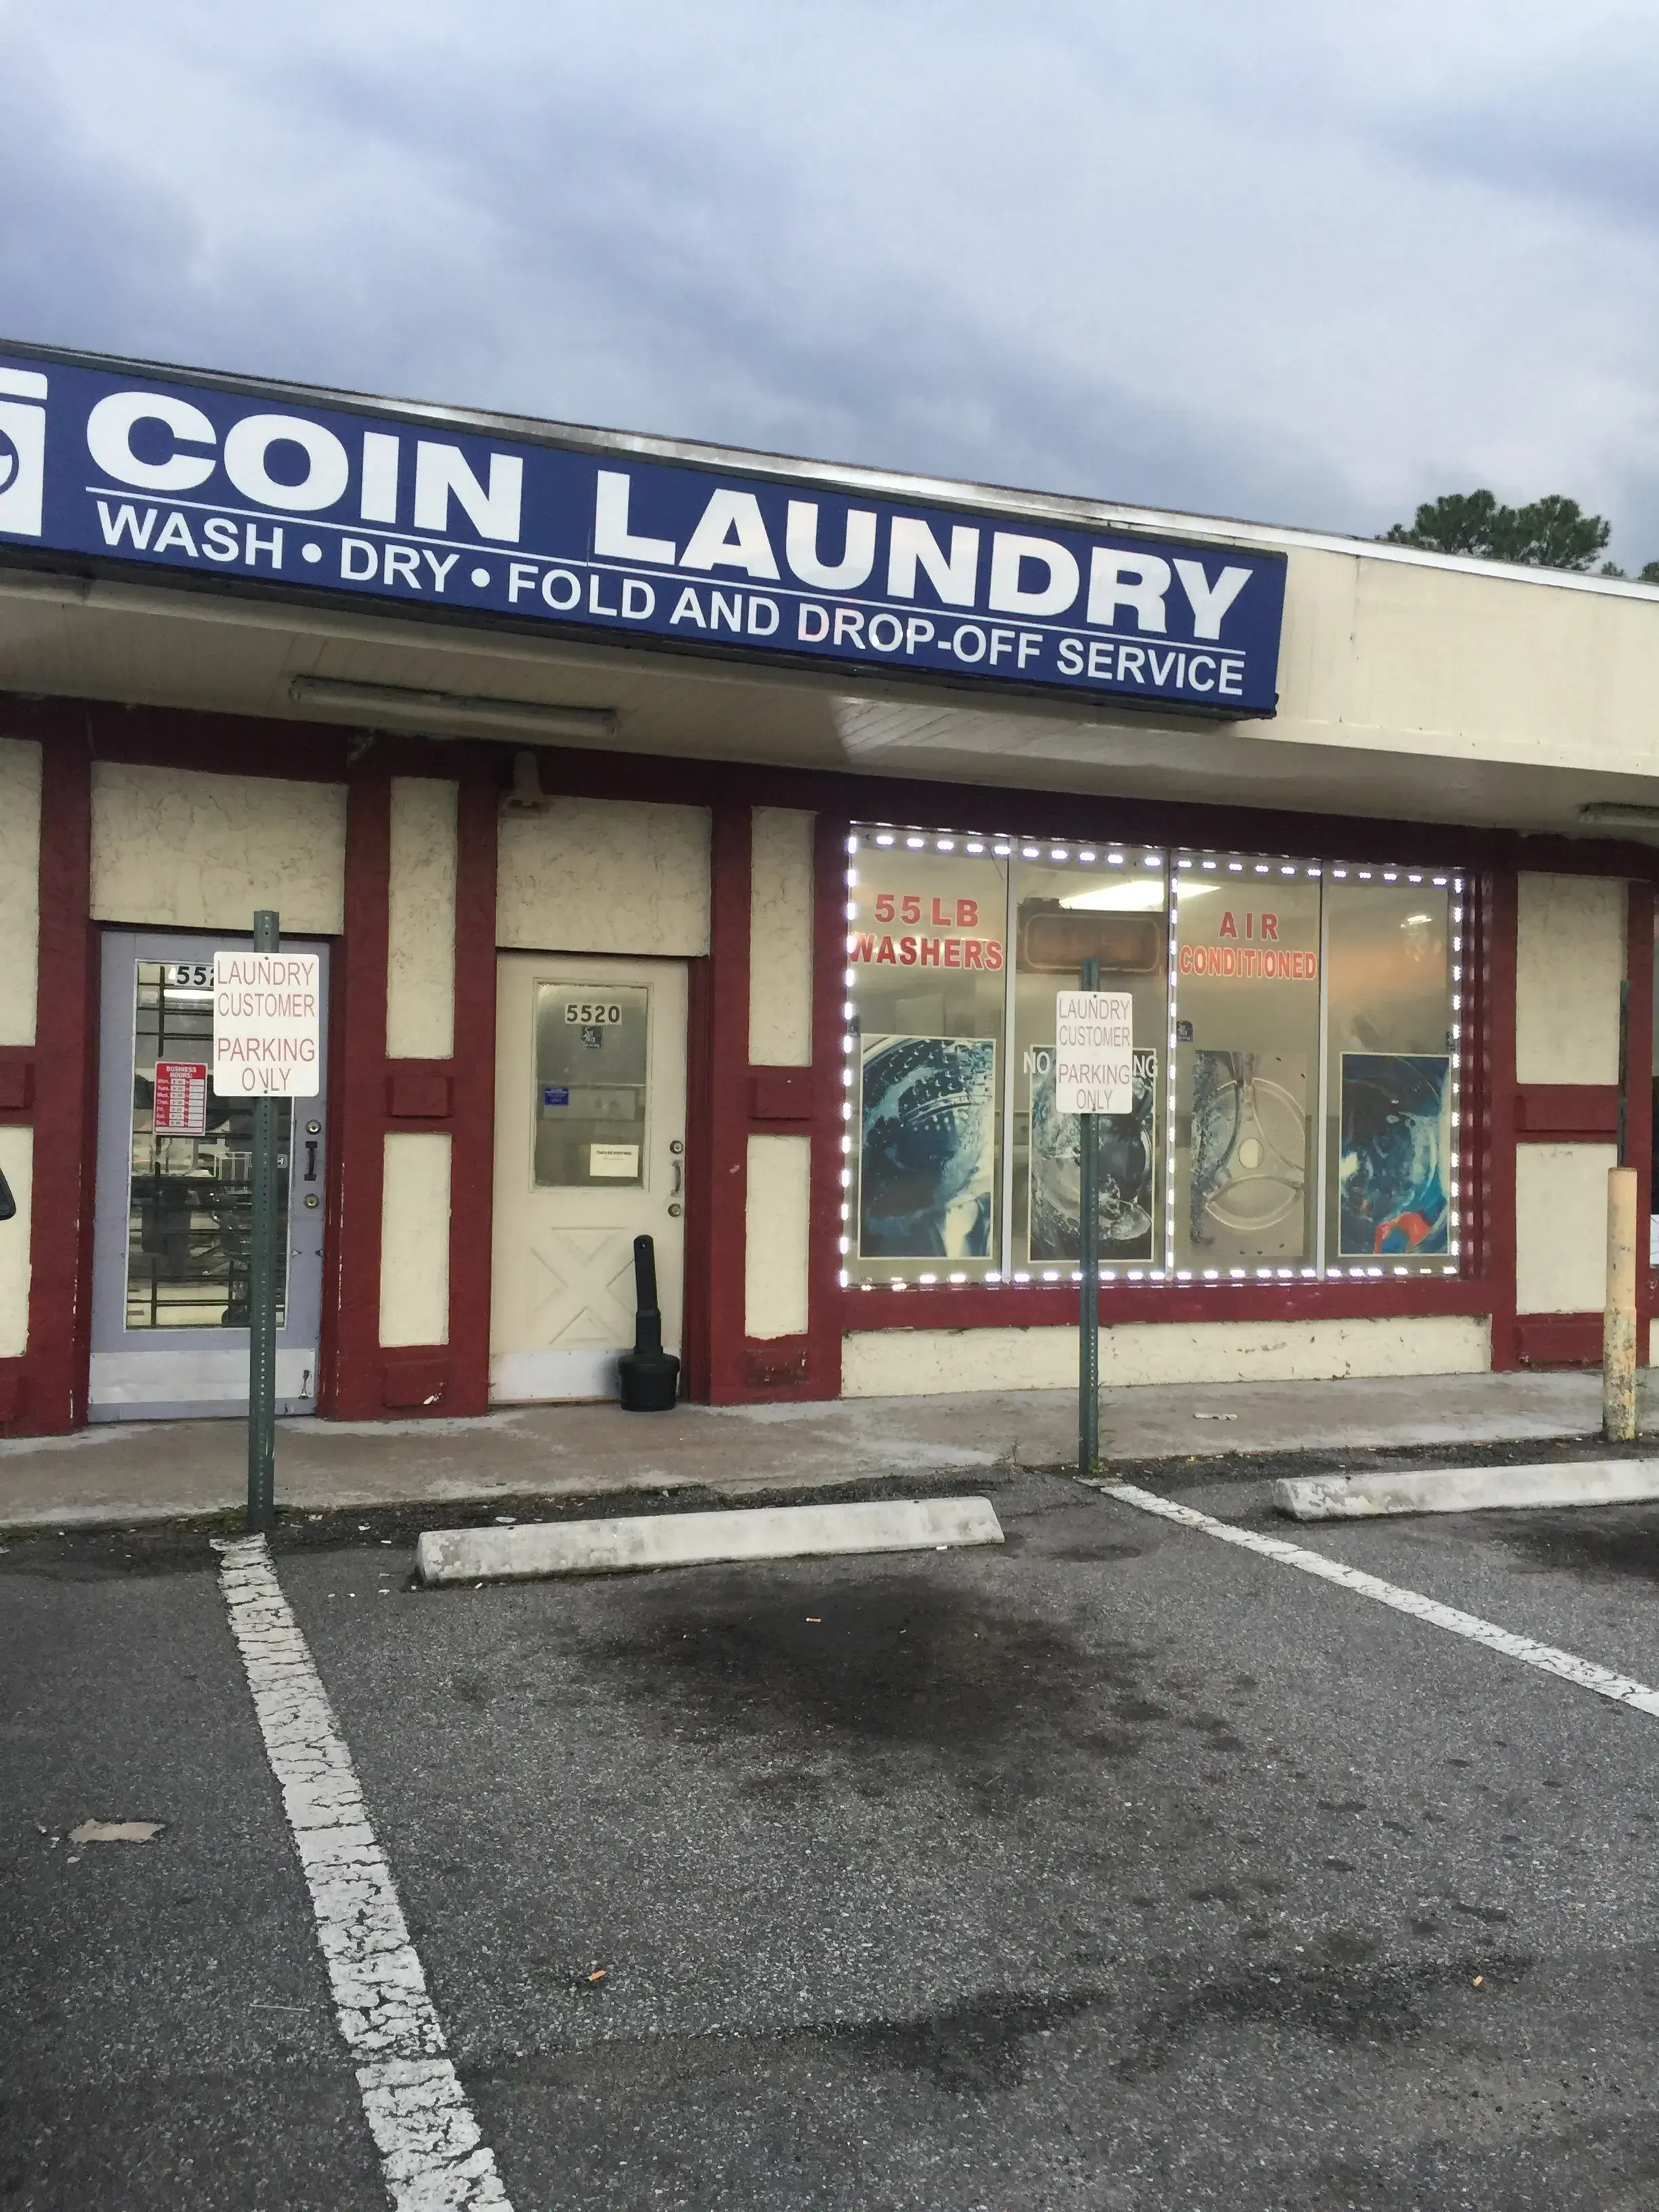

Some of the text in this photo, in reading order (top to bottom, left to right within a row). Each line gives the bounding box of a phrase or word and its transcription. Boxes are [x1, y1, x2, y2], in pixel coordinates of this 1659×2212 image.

[86, 390, 1253, 640] COIN LAUNDRY
[96, 500, 1245, 695] WASH DRY FOLD AND DROP-OFF SERVICE
[1218, 910, 1279, 941] AIR
[850, 933, 1004, 971] WASHERS
[1179, 945, 1317, 980] CONDITIONED
[217, 960, 314, 986] LAUNDRY
[218, 991, 316, 1017] CUSTOMER
[567, 1004, 620, 1023] 5520
[1059, 998, 1130, 1020] LAUNDRY
[1059, 1024, 1131, 1047] CUSTOMER
[217, 1038, 315, 1063] PARKING
[1023, 1051, 1050, 1075] NO
[241, 1067, 291, 1092] ONLY
[1059, 1063, 1130, 1086] PARKING
[1076, 1088, 1113, 1110] ONLY
